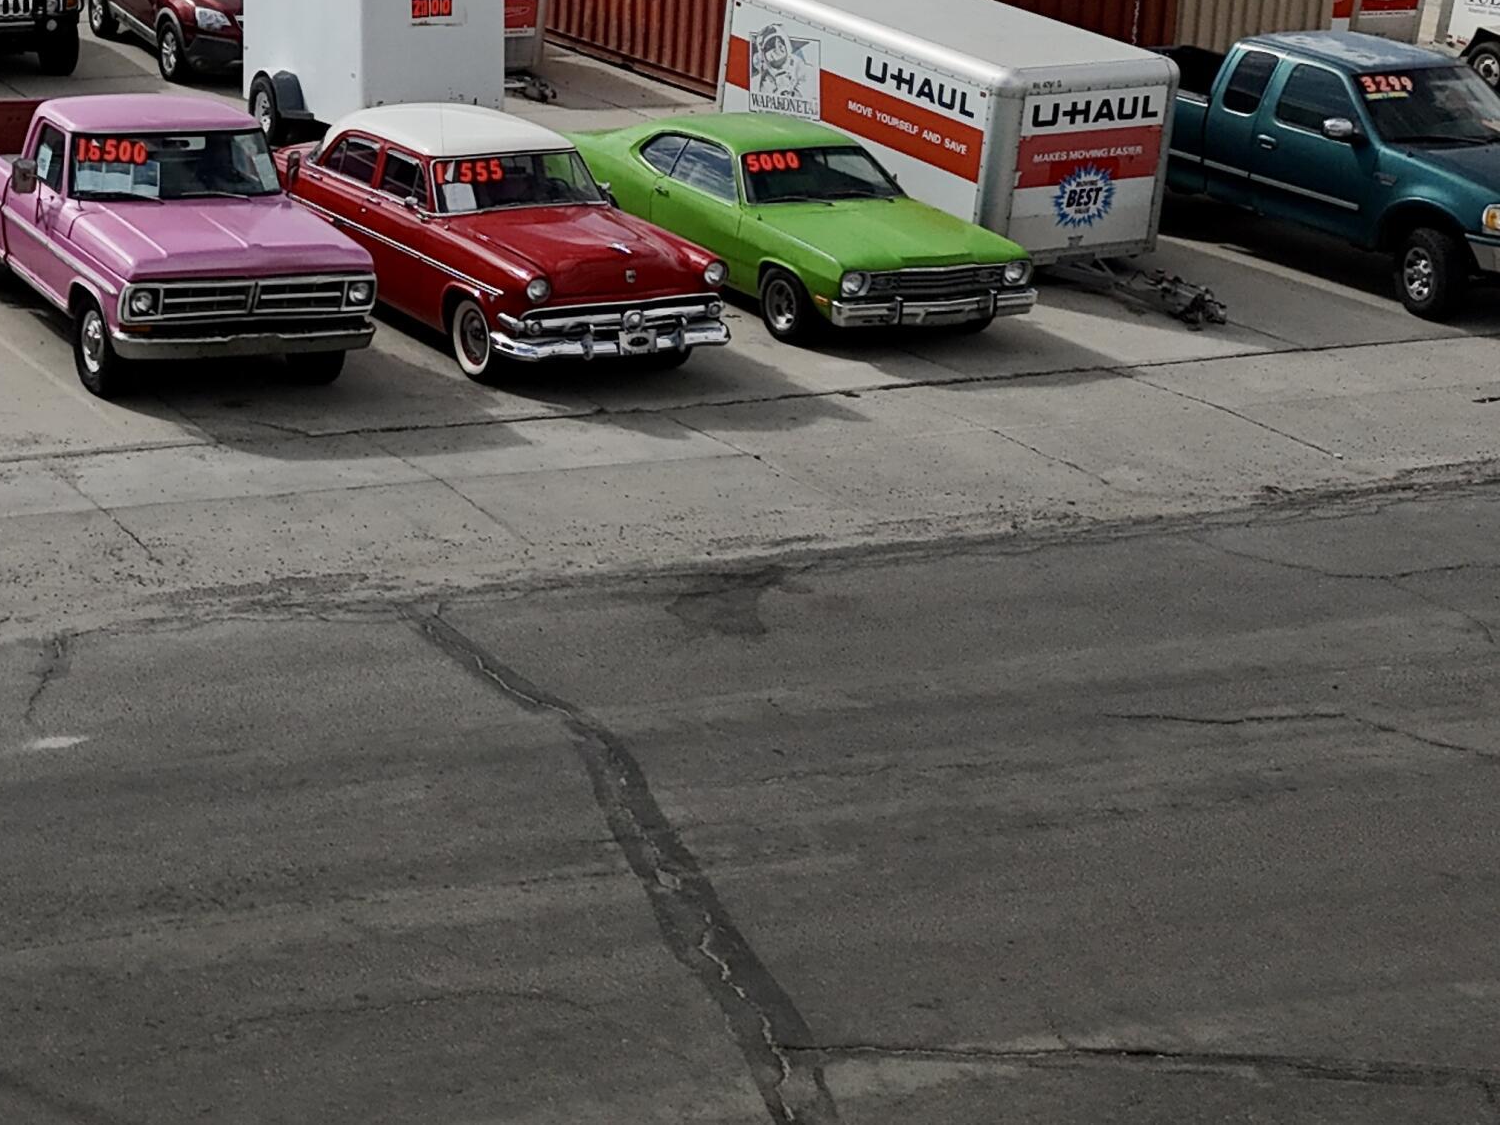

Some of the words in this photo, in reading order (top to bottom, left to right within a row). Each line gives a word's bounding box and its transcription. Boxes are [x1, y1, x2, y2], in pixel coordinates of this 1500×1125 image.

[865, 56, 974, 119] U-HAUL
[1360, 75, 1413, 92] 3299
[1032, 95, 1158, 127] U-HAUL
[847, 100, 873, 118] MOVE
[875, 110, 919, 135] YOURSELF
[922, 130, 941, 144] AND
[944, 137, 968, 155] SAVE
[745, 150, 799, 173] 5000
[1033, 151, 1067, 163] MAKES
[1069, 148, 1108, 160] MOVING
[1110, 145, 1143, 155] EASIER
[1066, 187, 1103, 208] BEST
